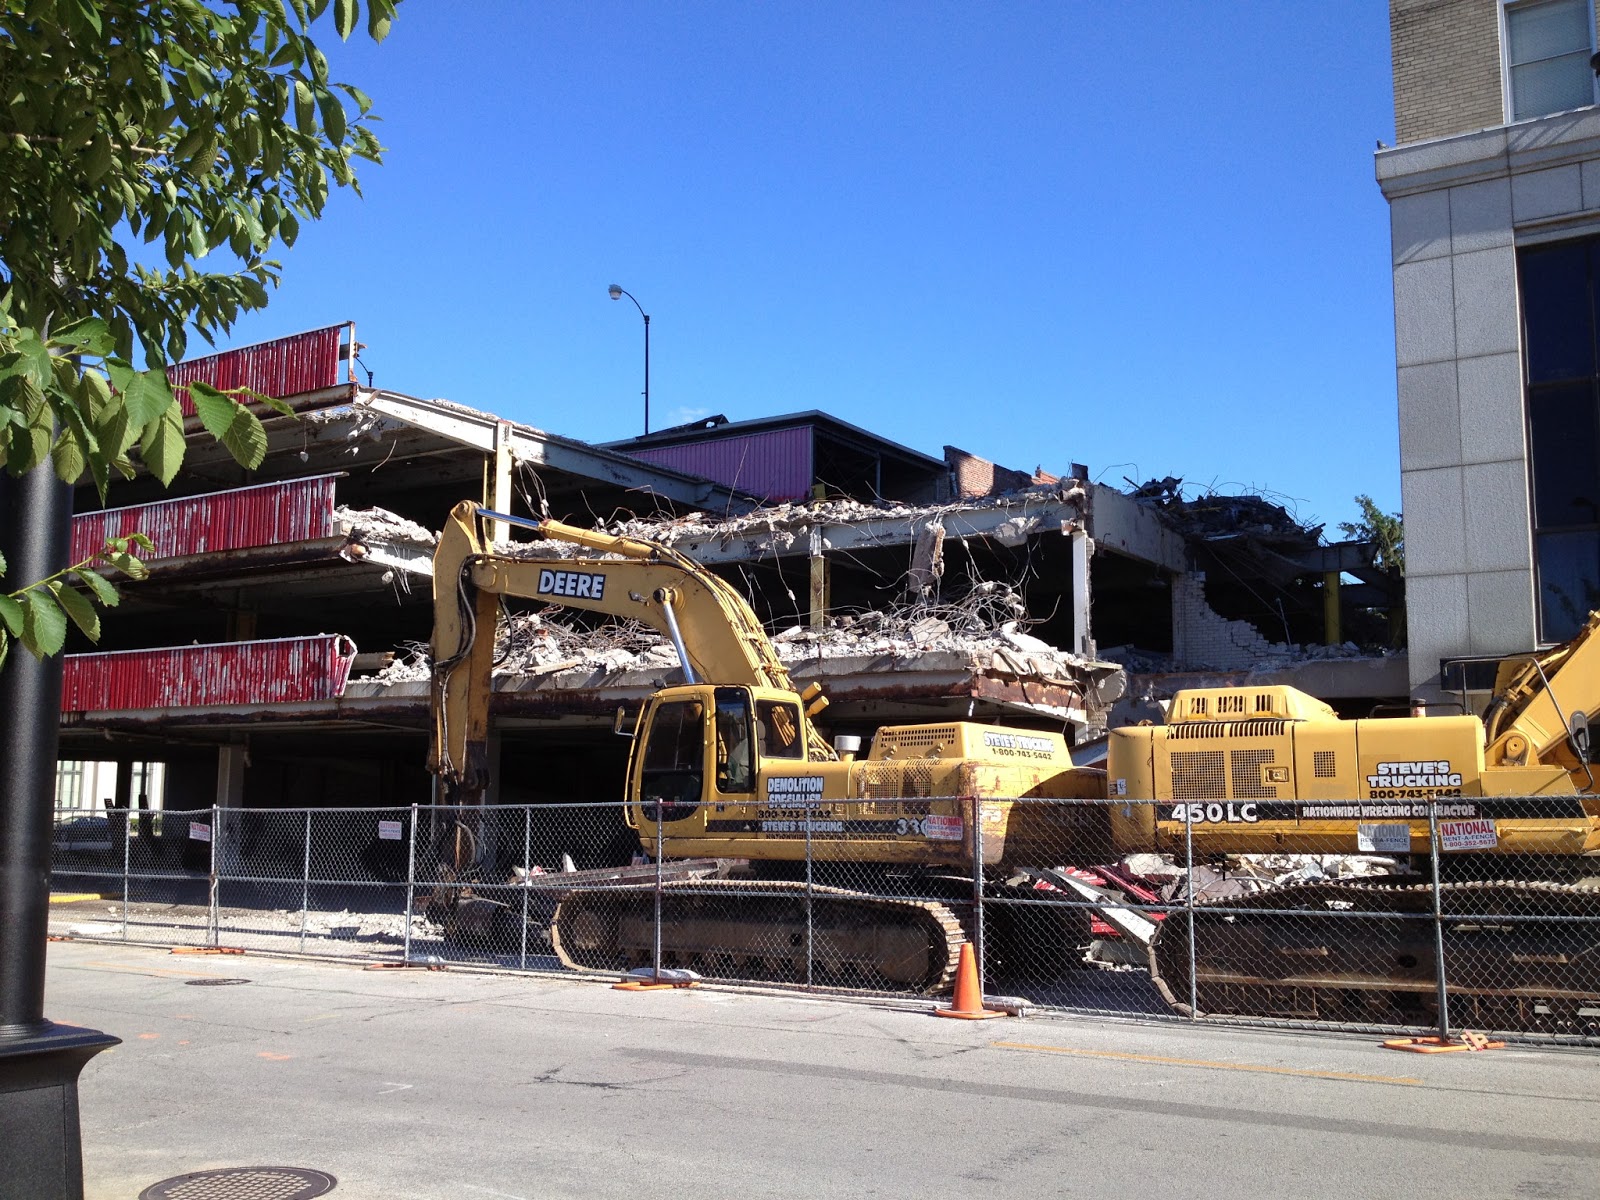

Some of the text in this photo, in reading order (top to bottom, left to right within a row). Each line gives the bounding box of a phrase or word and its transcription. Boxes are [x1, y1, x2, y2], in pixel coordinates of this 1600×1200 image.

[538, 570, 605, 599] DEERE
[1016, 735, 1054, 753] TRUCKING
[1378, 762, 1449, 775] STEVE'S
[767, 777, 824, 793] DEMOLITION
[1368, 774, 1462, 788] TRUCKING
[768, 793, 821, 808] SPECIALIST
[1369, 789, 1461, 799] 800-743-5442
[1302, 804, 1475, 817] NATIONWIDE WRECKING CORACTOR
[927, 814, 961, 827] NATIONAL
[1359, 825, 1408, 838] NATIONAL
[1441, 820, 1493, 836] NATIONAL
[1442, 834, 1495, 842] RENT-A-FENCE
[1444, 839, 1495, 848] 1-800-352-5675
